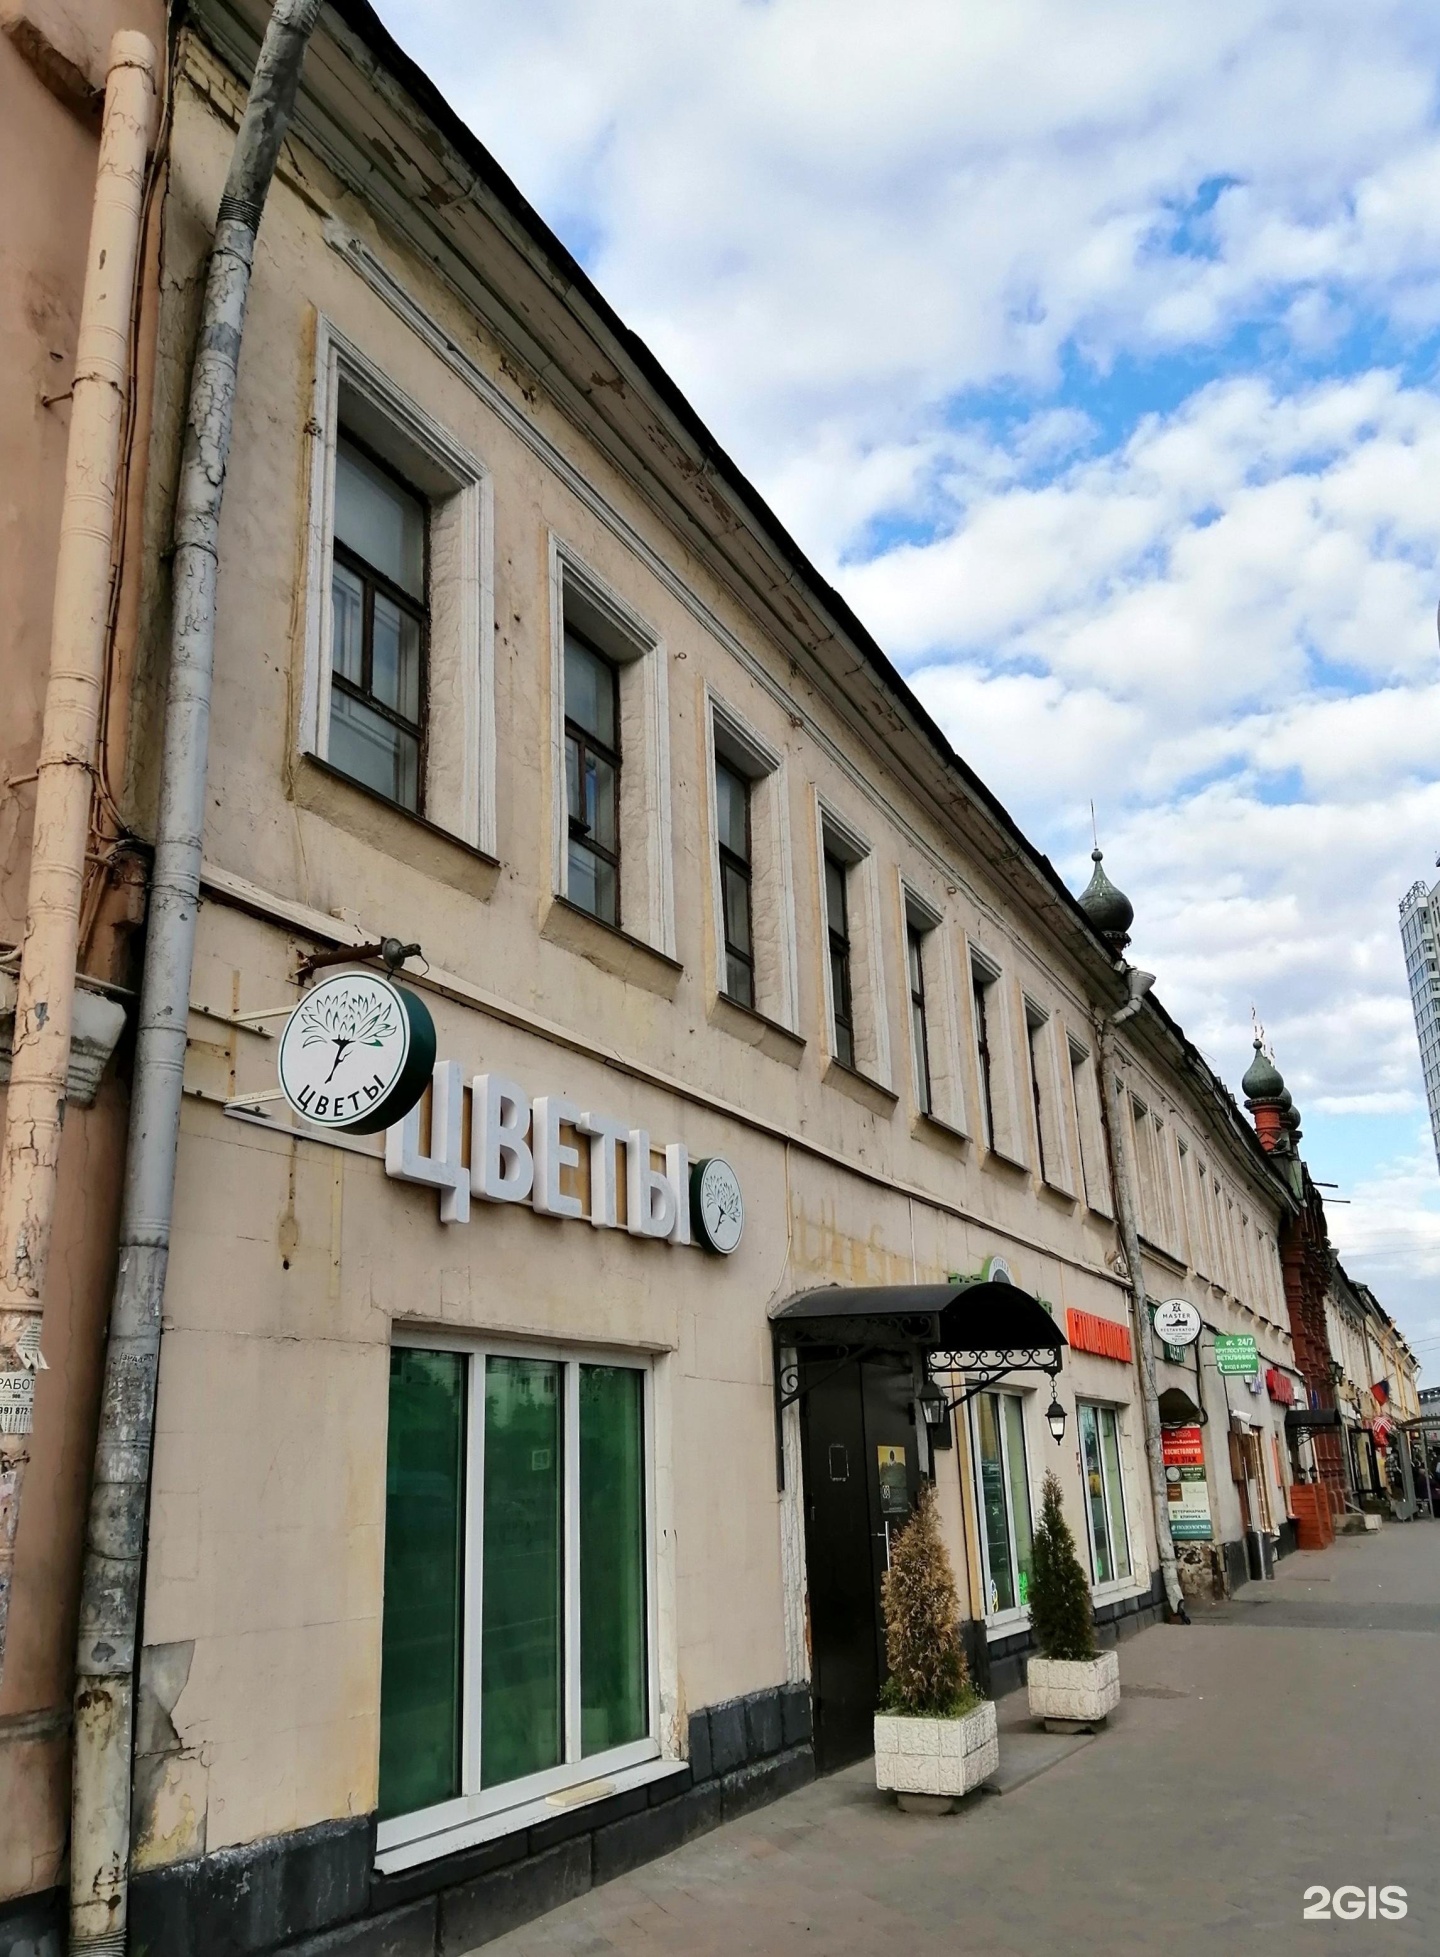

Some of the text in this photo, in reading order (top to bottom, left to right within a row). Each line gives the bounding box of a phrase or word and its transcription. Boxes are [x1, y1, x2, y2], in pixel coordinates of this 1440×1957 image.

[297, 1074, 385, 1118] ЦВЕТЫ
[386, 1060, 692, 1246] ЦВЕТЫ
[1237, 1338, 1254, 1346] 24/7
